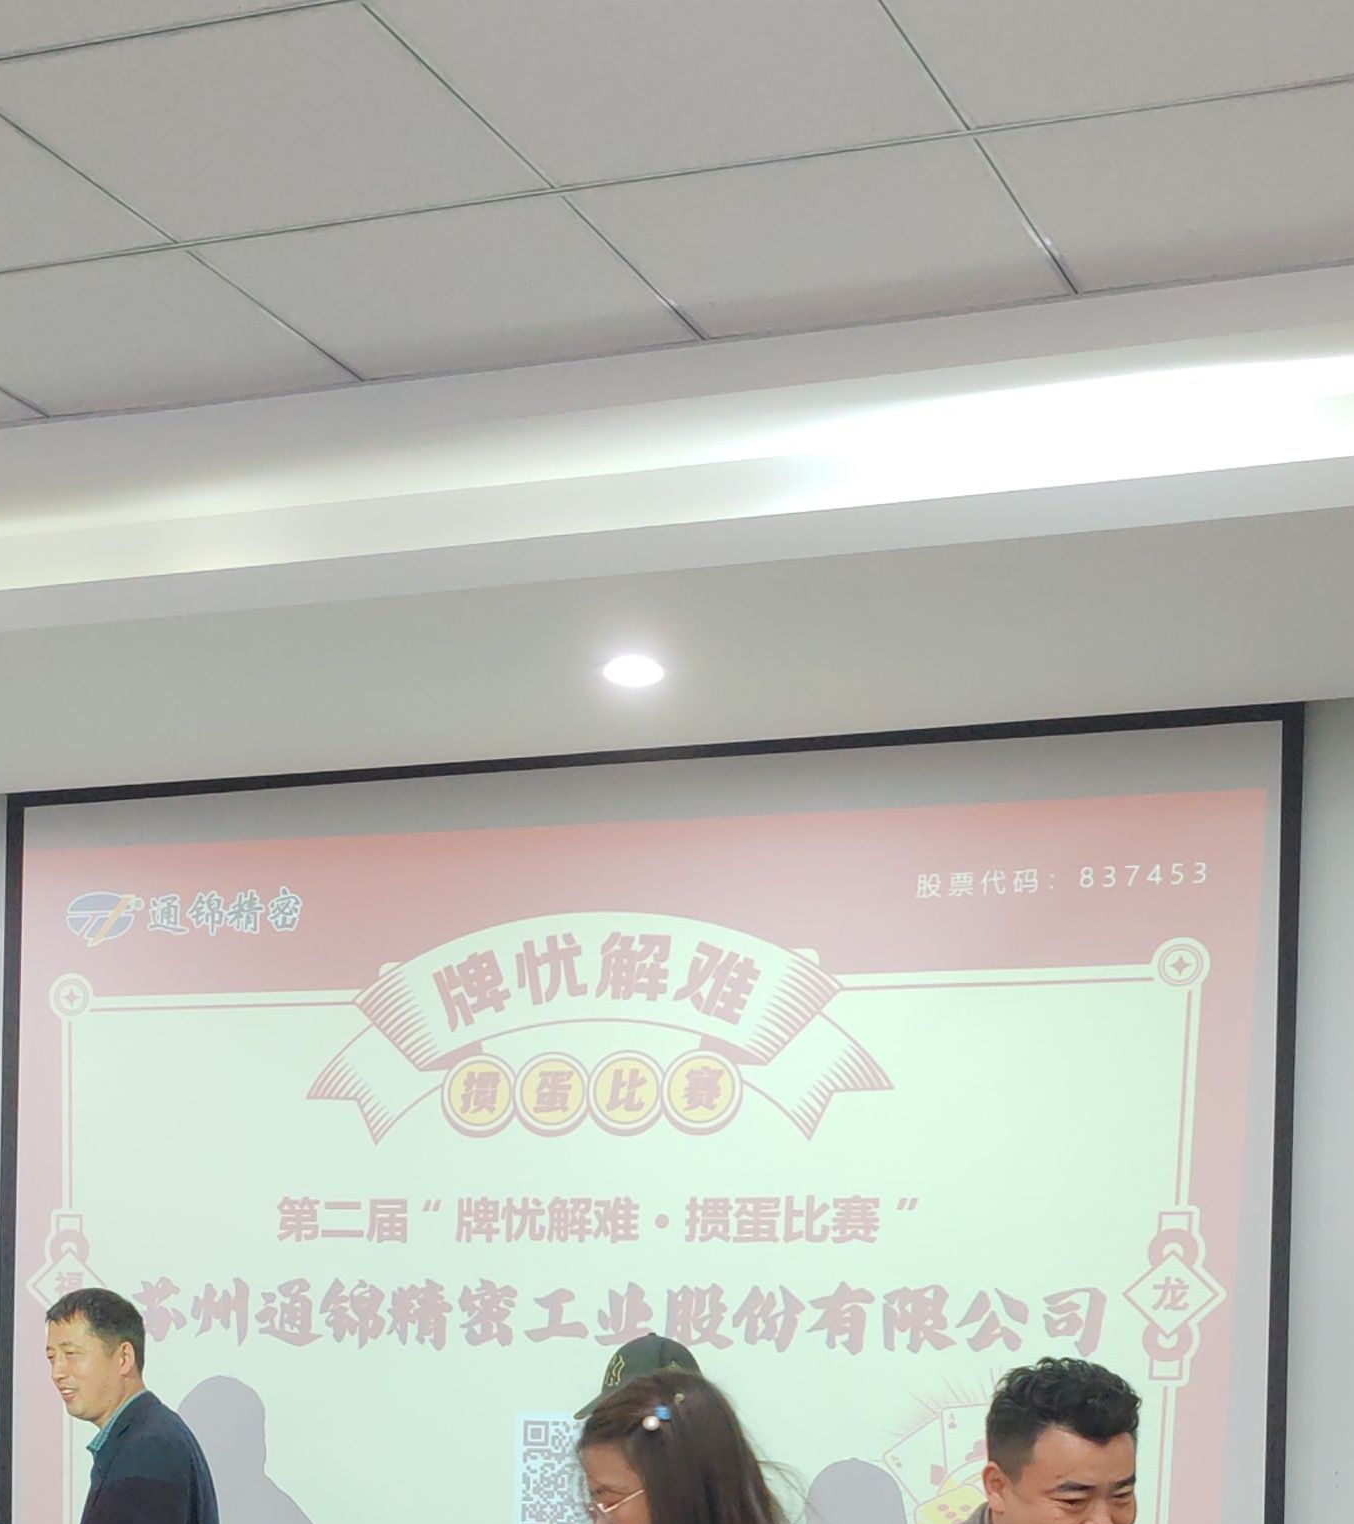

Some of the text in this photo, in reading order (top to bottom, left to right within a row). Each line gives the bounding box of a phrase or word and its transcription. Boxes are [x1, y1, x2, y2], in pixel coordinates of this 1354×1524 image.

[1079, 862, 1207, 888] 837453
[147, 886, 303, 936] 通锦精密
[432, 931, 761, 1033] 牌忧解难
[460, 1066, 725, 1115] 掼蛋比赛
[131, 1276, 1107, 1357] 苏州通锦精密工业股份有限公司
[1152, 1276, 1190, 1311] 龙
